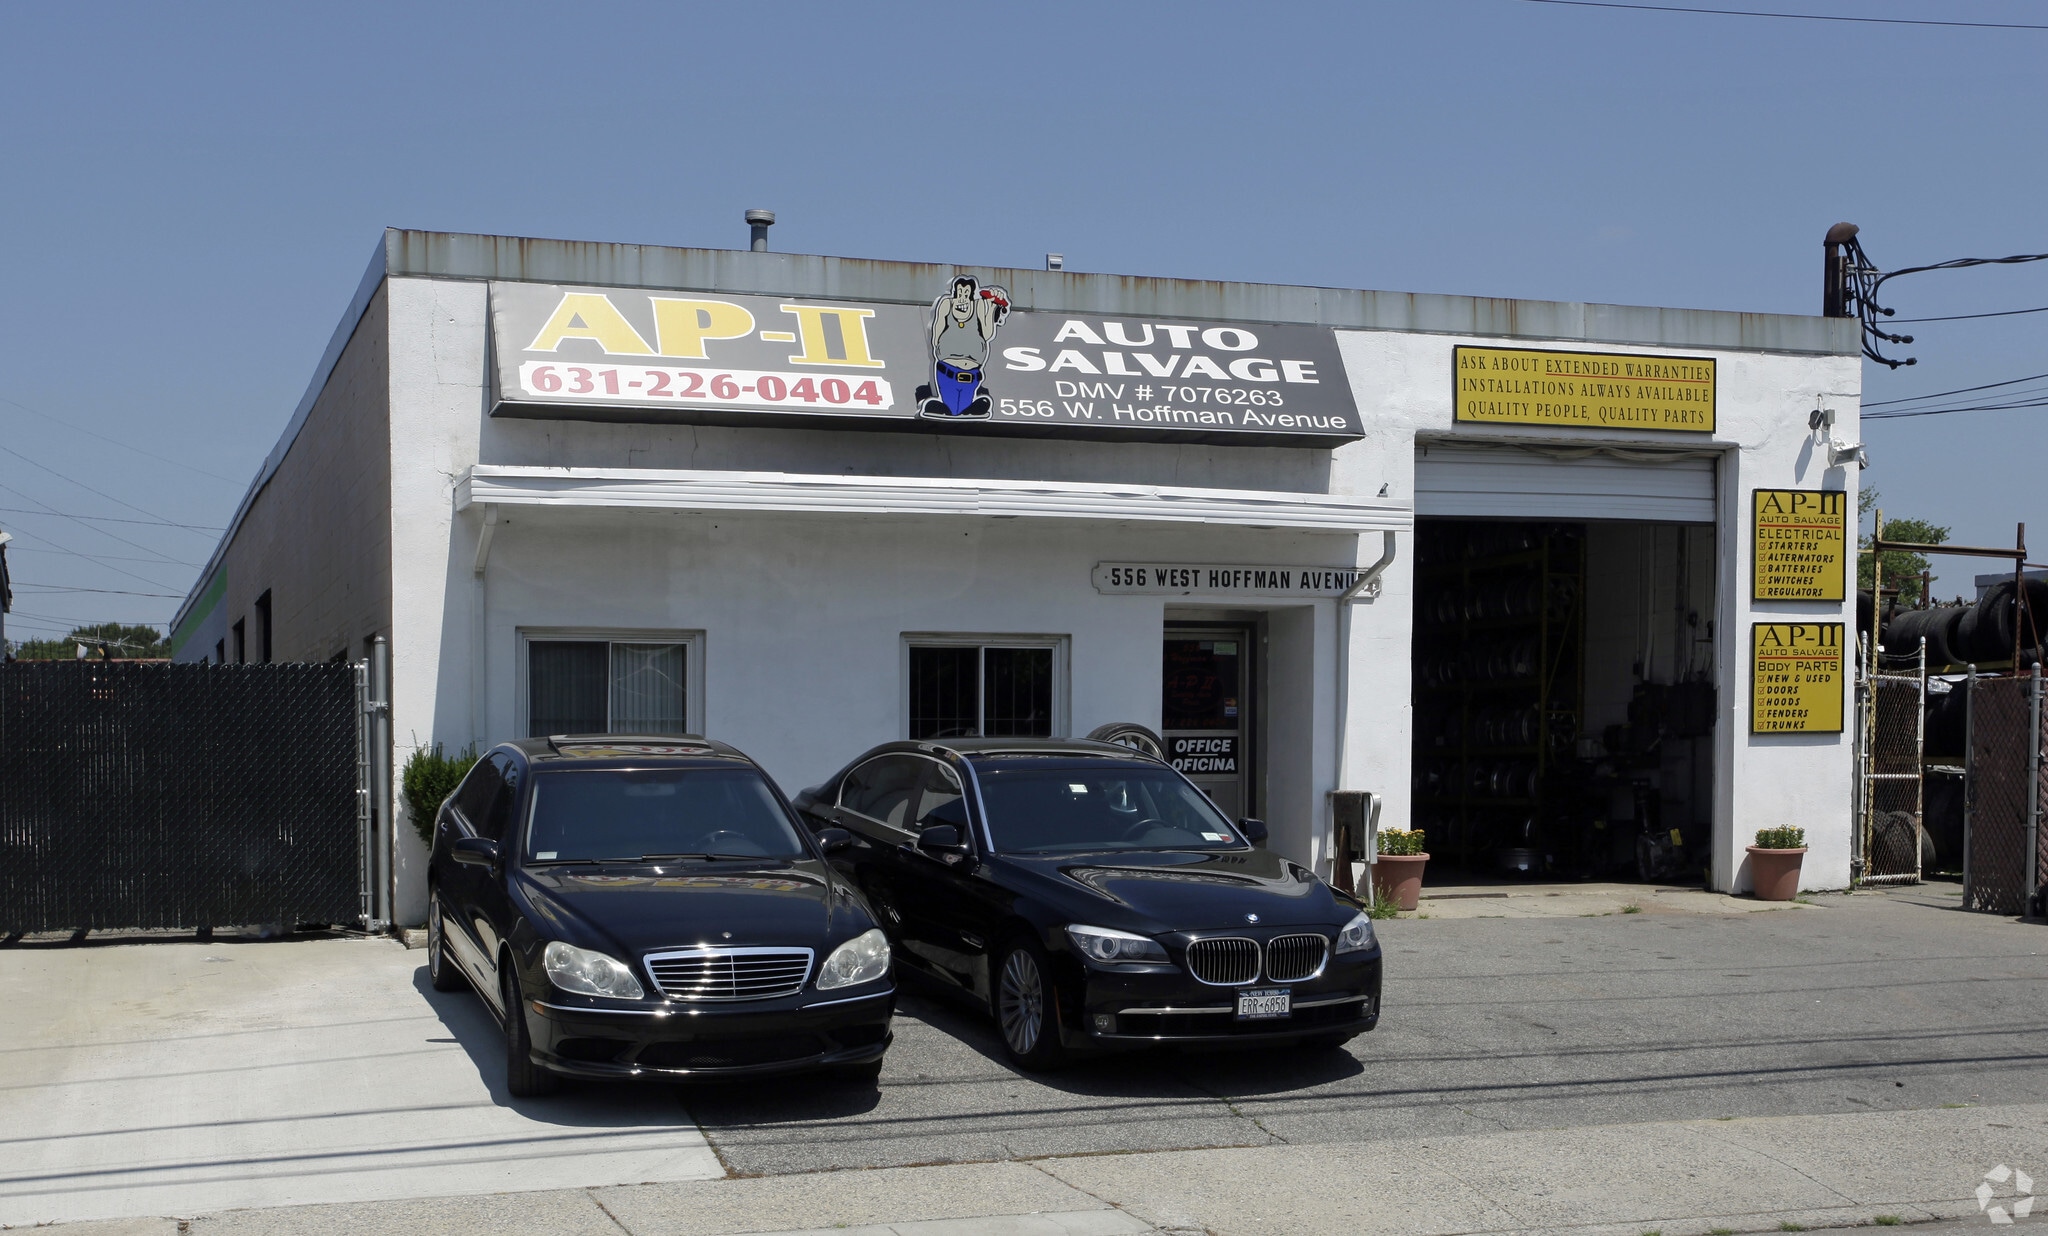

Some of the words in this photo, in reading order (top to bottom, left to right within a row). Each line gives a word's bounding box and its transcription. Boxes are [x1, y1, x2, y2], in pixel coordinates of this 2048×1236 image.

[522, 292, 885, 368] AP-II
[1053, 319, 1258, 351] AUTO
[1002, 347, 1320, 384] SALVAGE
[1461, 355, 1487, 370] ASK
[1492, 357, 1539, 372] ABOUT
[1546, 359, 1619, 376] EXTENDED
[1625, 363, 1711, 381] WARRANTIES
[531, 366, 883, 406] 631-226-0404
[1462, 378, 1574, 396] INSTALLATIONS
[1580, 384, 1630, 399] ALWAYS
[1636, 386, 1709, 402] AVAILABLE
[1055, 381, 1125, 399] DMV
[1135, 386, 1154, 401] #
[1161, 386, 1284, 406] 7076263
[1000, 399, 1055, 418] 556
[1063, 401, 1102, 419] W.
[1125, 403, 1234, 426] Hoffman
[1242, 409, 1347, 429] Avenue
[1468, 401, 1529, 417] QUALITY
[1536, 403, 1590, 421] PEOPLE,
[1598, 406, 1658, 423] QUALITY
[1664, 409, 1704, 424] PARTS
[1760, 492, 1840, 515] AP-II
[1794, 516, 1841, 524] SALVAGE
[1759, 528, 1841, 540] ELECTRICAL
[1768, 541, 1818, 551] STARTERS
[1768, 553, 1834, 563] ALTERNATORS
[1768, 564, 1823, 573] BATTERIES
[1111, 568, 1147, 587] 556
[1155, 568, 1201, 587] WEST
[1209, 570, 1290, 589] HOFFMAN
[1300, 571, 1365, 590] AVENU
[1768, 576, 1814, 585] SWITCHES
[1768, 588, 1823, 597] REGULATORS
[1759, 625, 1838, 647] AP-II
[1796, 662, 1838, 671] PARTS
[1767, 674, 1790, 683] NEW
[1794, 675, 1800, 683] &
[1806, 674, 1831, 683] USED
[1767, 686, 1799, 694] DOORS
[1766, 698, 1801, 706] HOODS
[1767, 709, 1809, 718] FENDERS
[1766, 721, 1806, 729] TRUNKS
[1175, 739, 1232, 753] OFFICE
[1172, 758, 1236, 771] OFICINA
